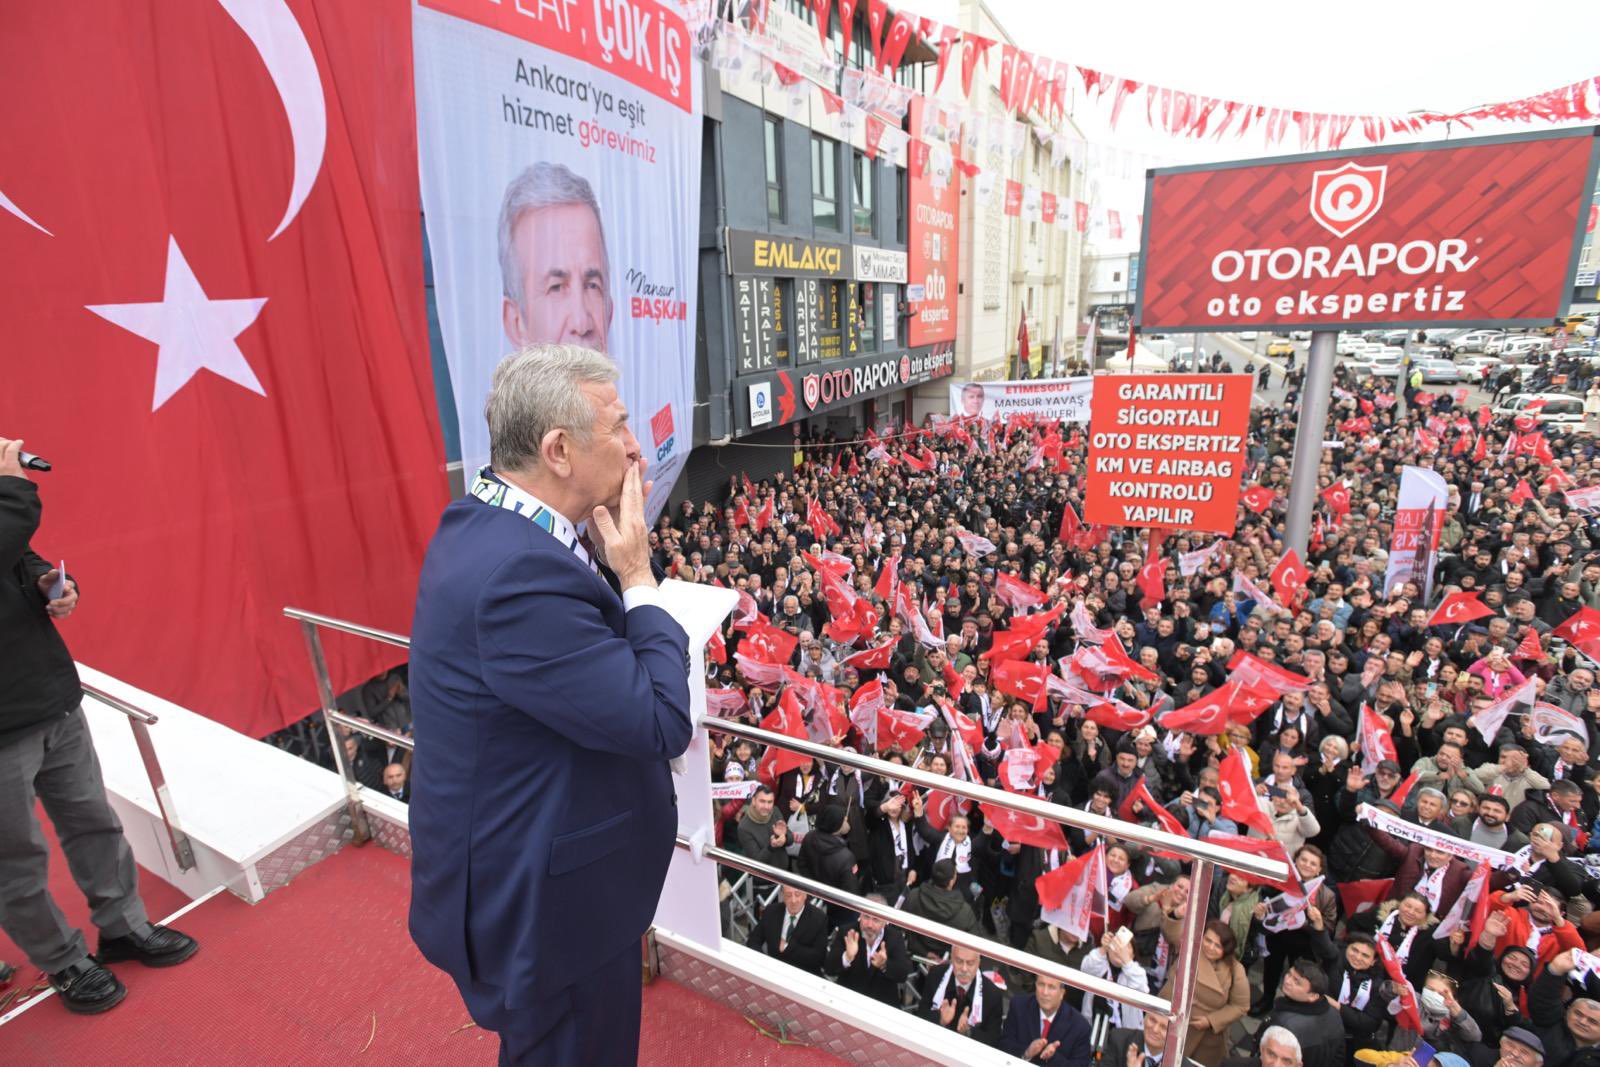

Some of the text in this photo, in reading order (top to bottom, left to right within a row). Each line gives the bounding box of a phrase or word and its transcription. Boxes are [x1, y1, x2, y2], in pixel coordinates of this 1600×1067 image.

[593, 0, 653, 73] ÇOK
[659, 12, 682, 97] İŞ
[515, 58, 646, 128] Ankara'ya eşit
[502, 94, 656, 163] hizmet görevimiz
[754, 239, 841, 275] EMLAKÇI
[1211, 238, 1479, 283] OTORAPOR
[625, 268, 675, 297] Mansur
[926, 269, 945, 301] oto
[773, 286, 783, 332] ARSA
[809, 280, 819, 359] DÜKKAN
[848, 283, 857, 351] TARLA
[1207, 285, 1466, 320] oto ekspertiz
[739, 280, 753, 369] SATILIK
[760, 281, 772, 366] KİRALIK
[797, 291, 806, 354] ARSA
[820, 360, 898, 404] OTORAPOR
[911, 357, 923, 374] oto
[924, 349, 953, 372] ekspertiz
[1005, 381, 1071, 395] ETİMESGUT
[994, 395, 1085, 408] MANSUR YAVAŞ
[657, 436, 674, 461] CHP
[1093, 433, 1132, 449] OTO
[1096, 457, 1232, 478] KM VE AIRBAG
[1109, 481, 1213, 502] KONTROLÜ
[1122, 505, 1194, 525] YAPILIR
[712, 788, 743, 798] AŞKAN
[1385, 823, 1409, 838] ÇOK
